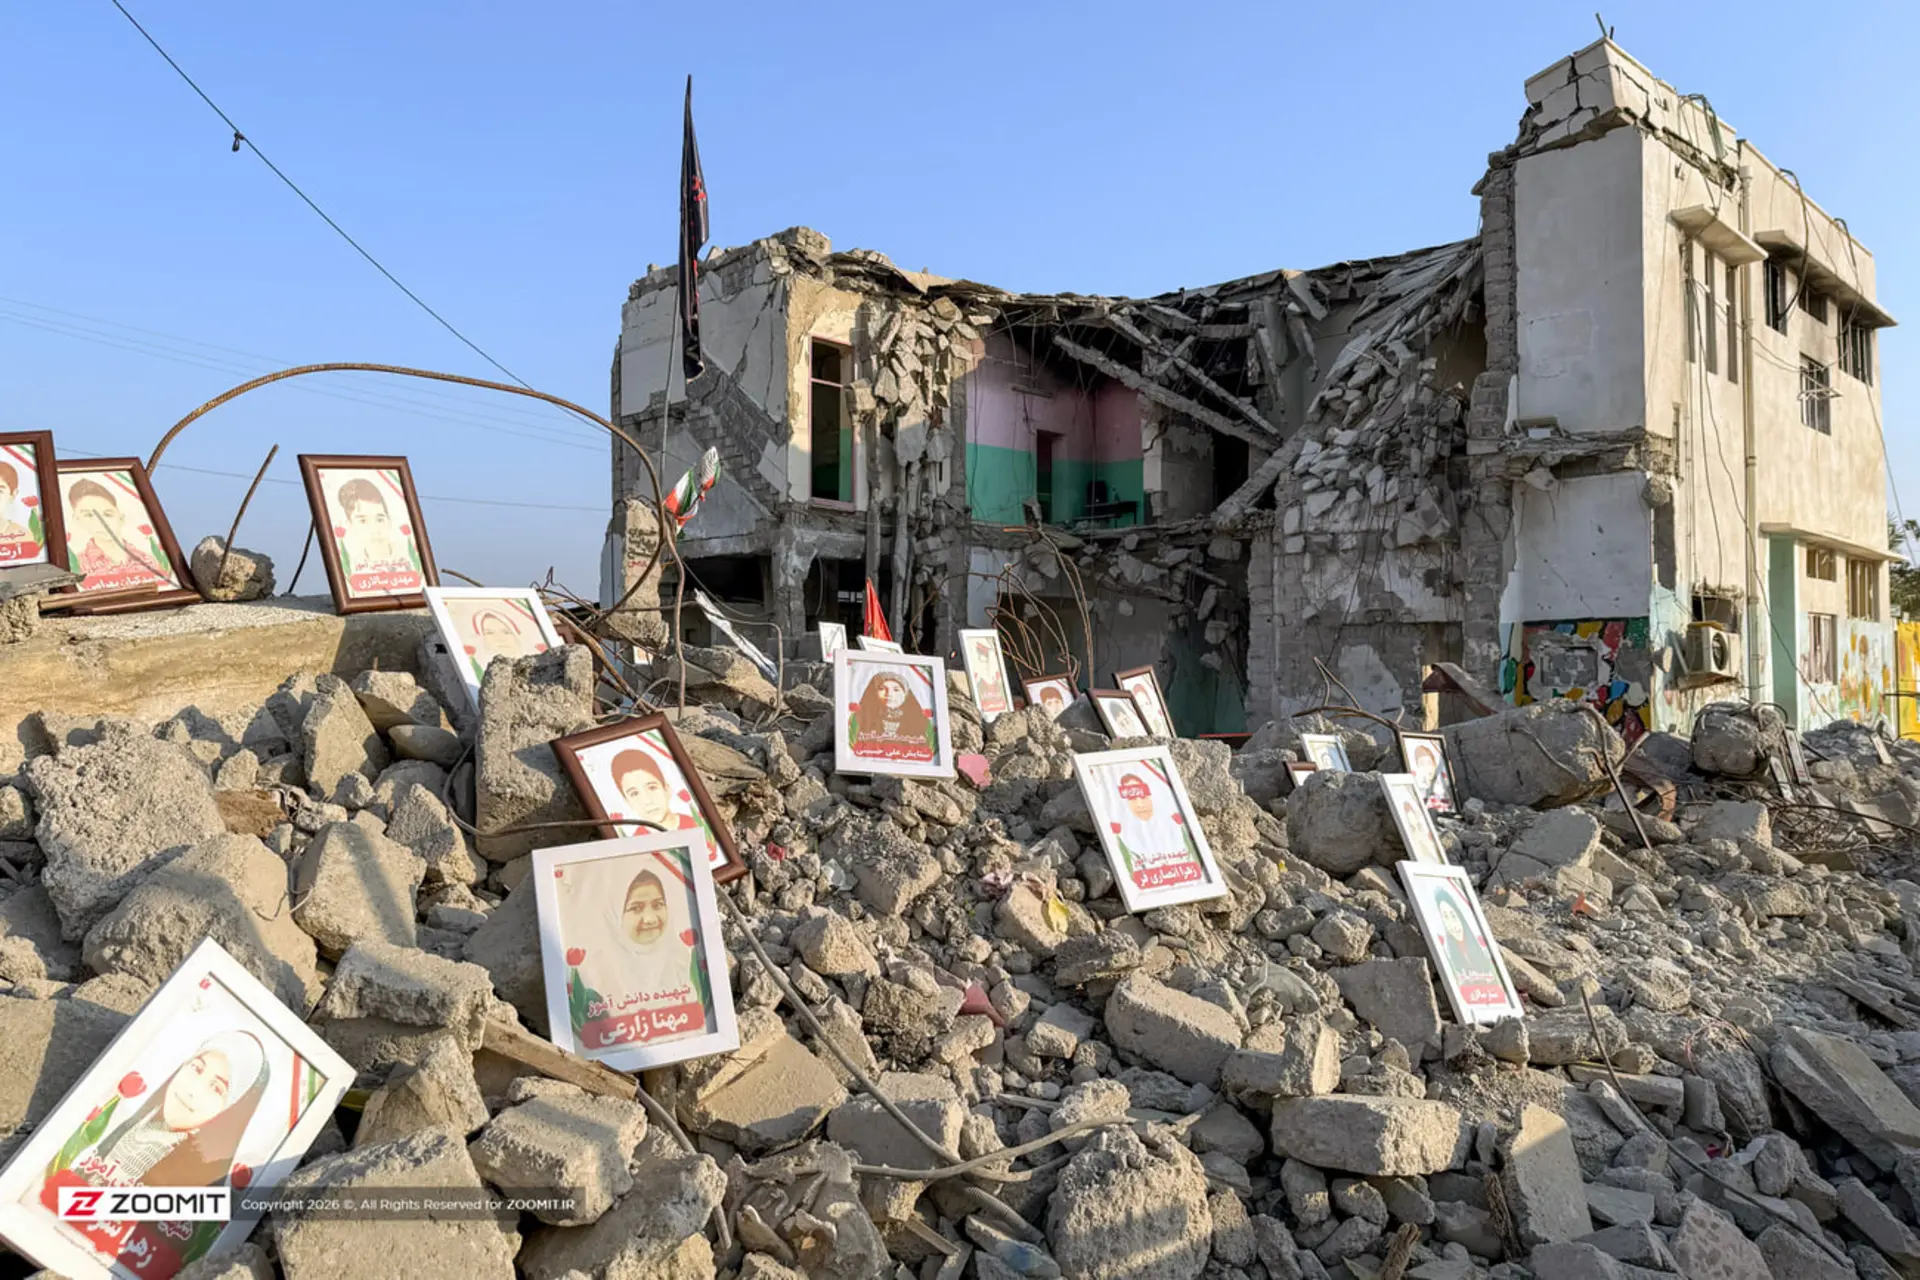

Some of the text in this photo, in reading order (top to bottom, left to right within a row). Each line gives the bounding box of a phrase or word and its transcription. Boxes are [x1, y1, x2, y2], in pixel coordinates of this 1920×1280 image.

[587, 983, 691, 1018] شهیده دانش آموز
[600, 1011, 689, 1045] مهنا زارعی
[79, 1149, 122, 1178] آموز
[117, 1225, 158, 1269] زهرا
